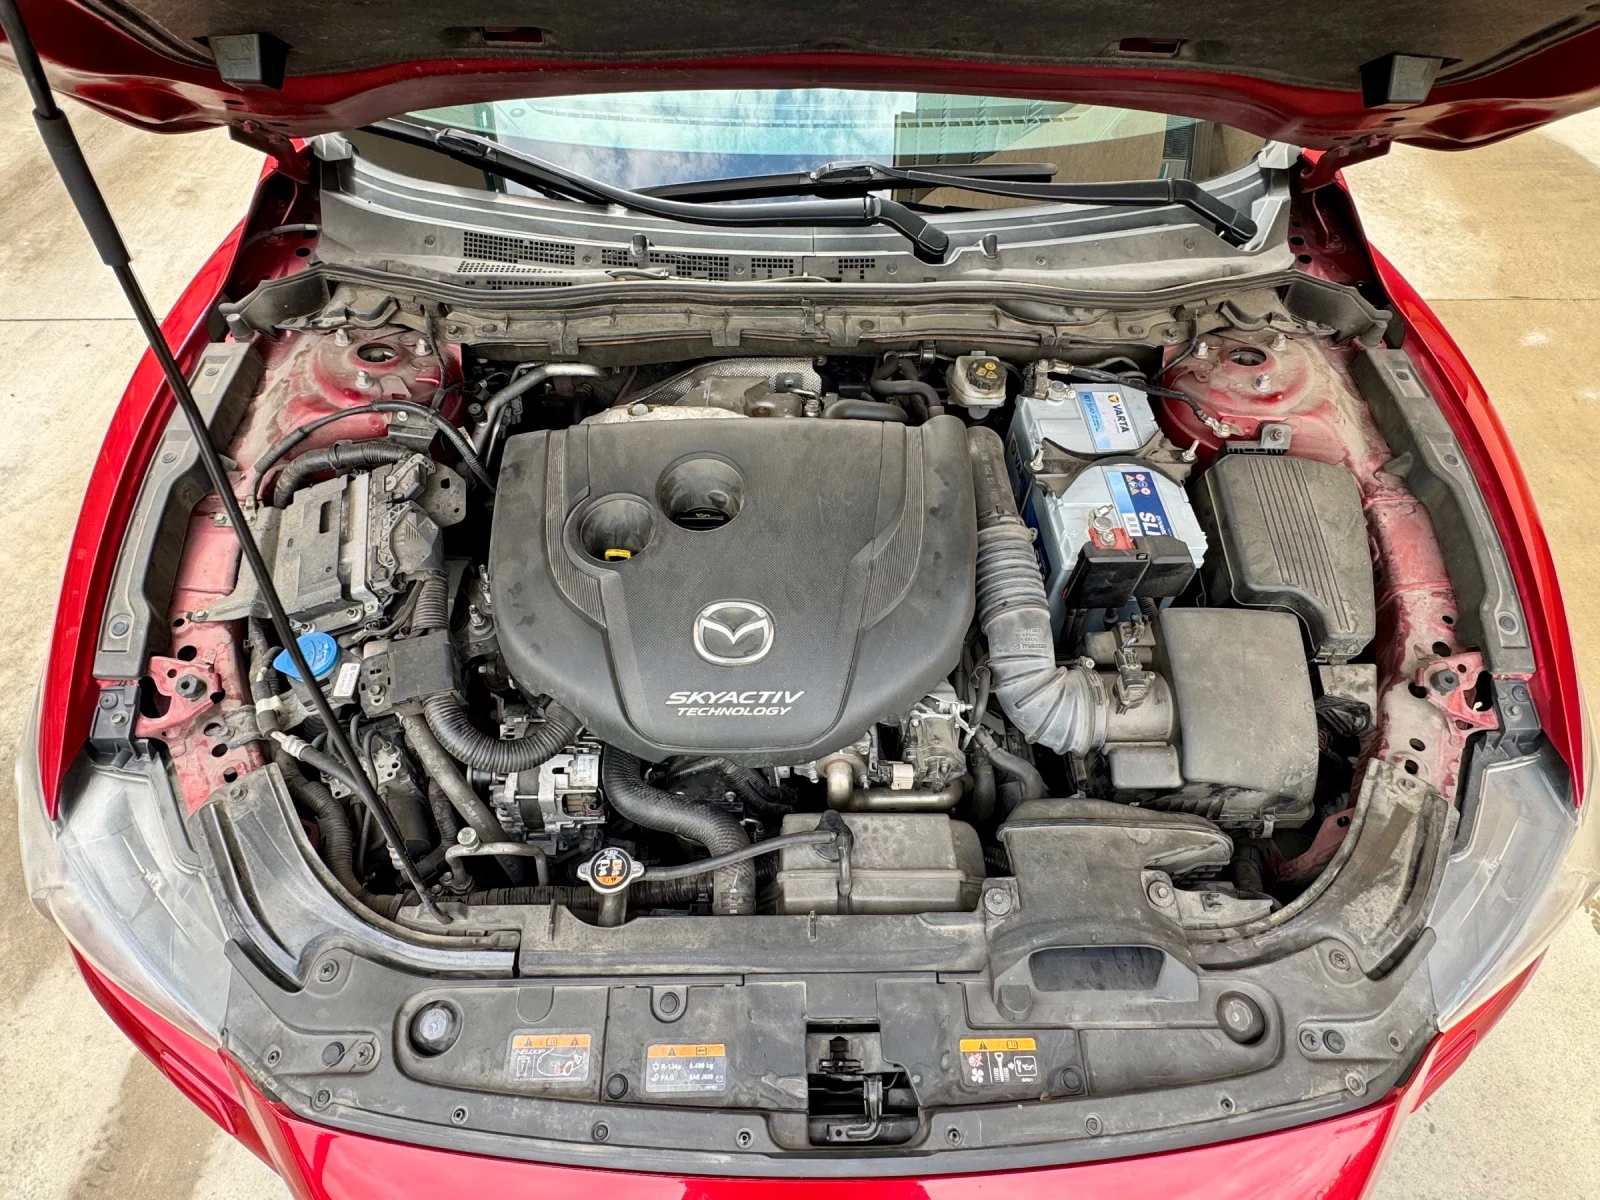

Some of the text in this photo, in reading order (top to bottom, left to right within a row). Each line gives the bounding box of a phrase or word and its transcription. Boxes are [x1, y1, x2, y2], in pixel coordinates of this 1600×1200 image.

[1112, 404, 1131, 433] VARTA
[665, 690, 806, 705] SKYACTIV
[677, 706, 793, 717] TECHNOLOGY
